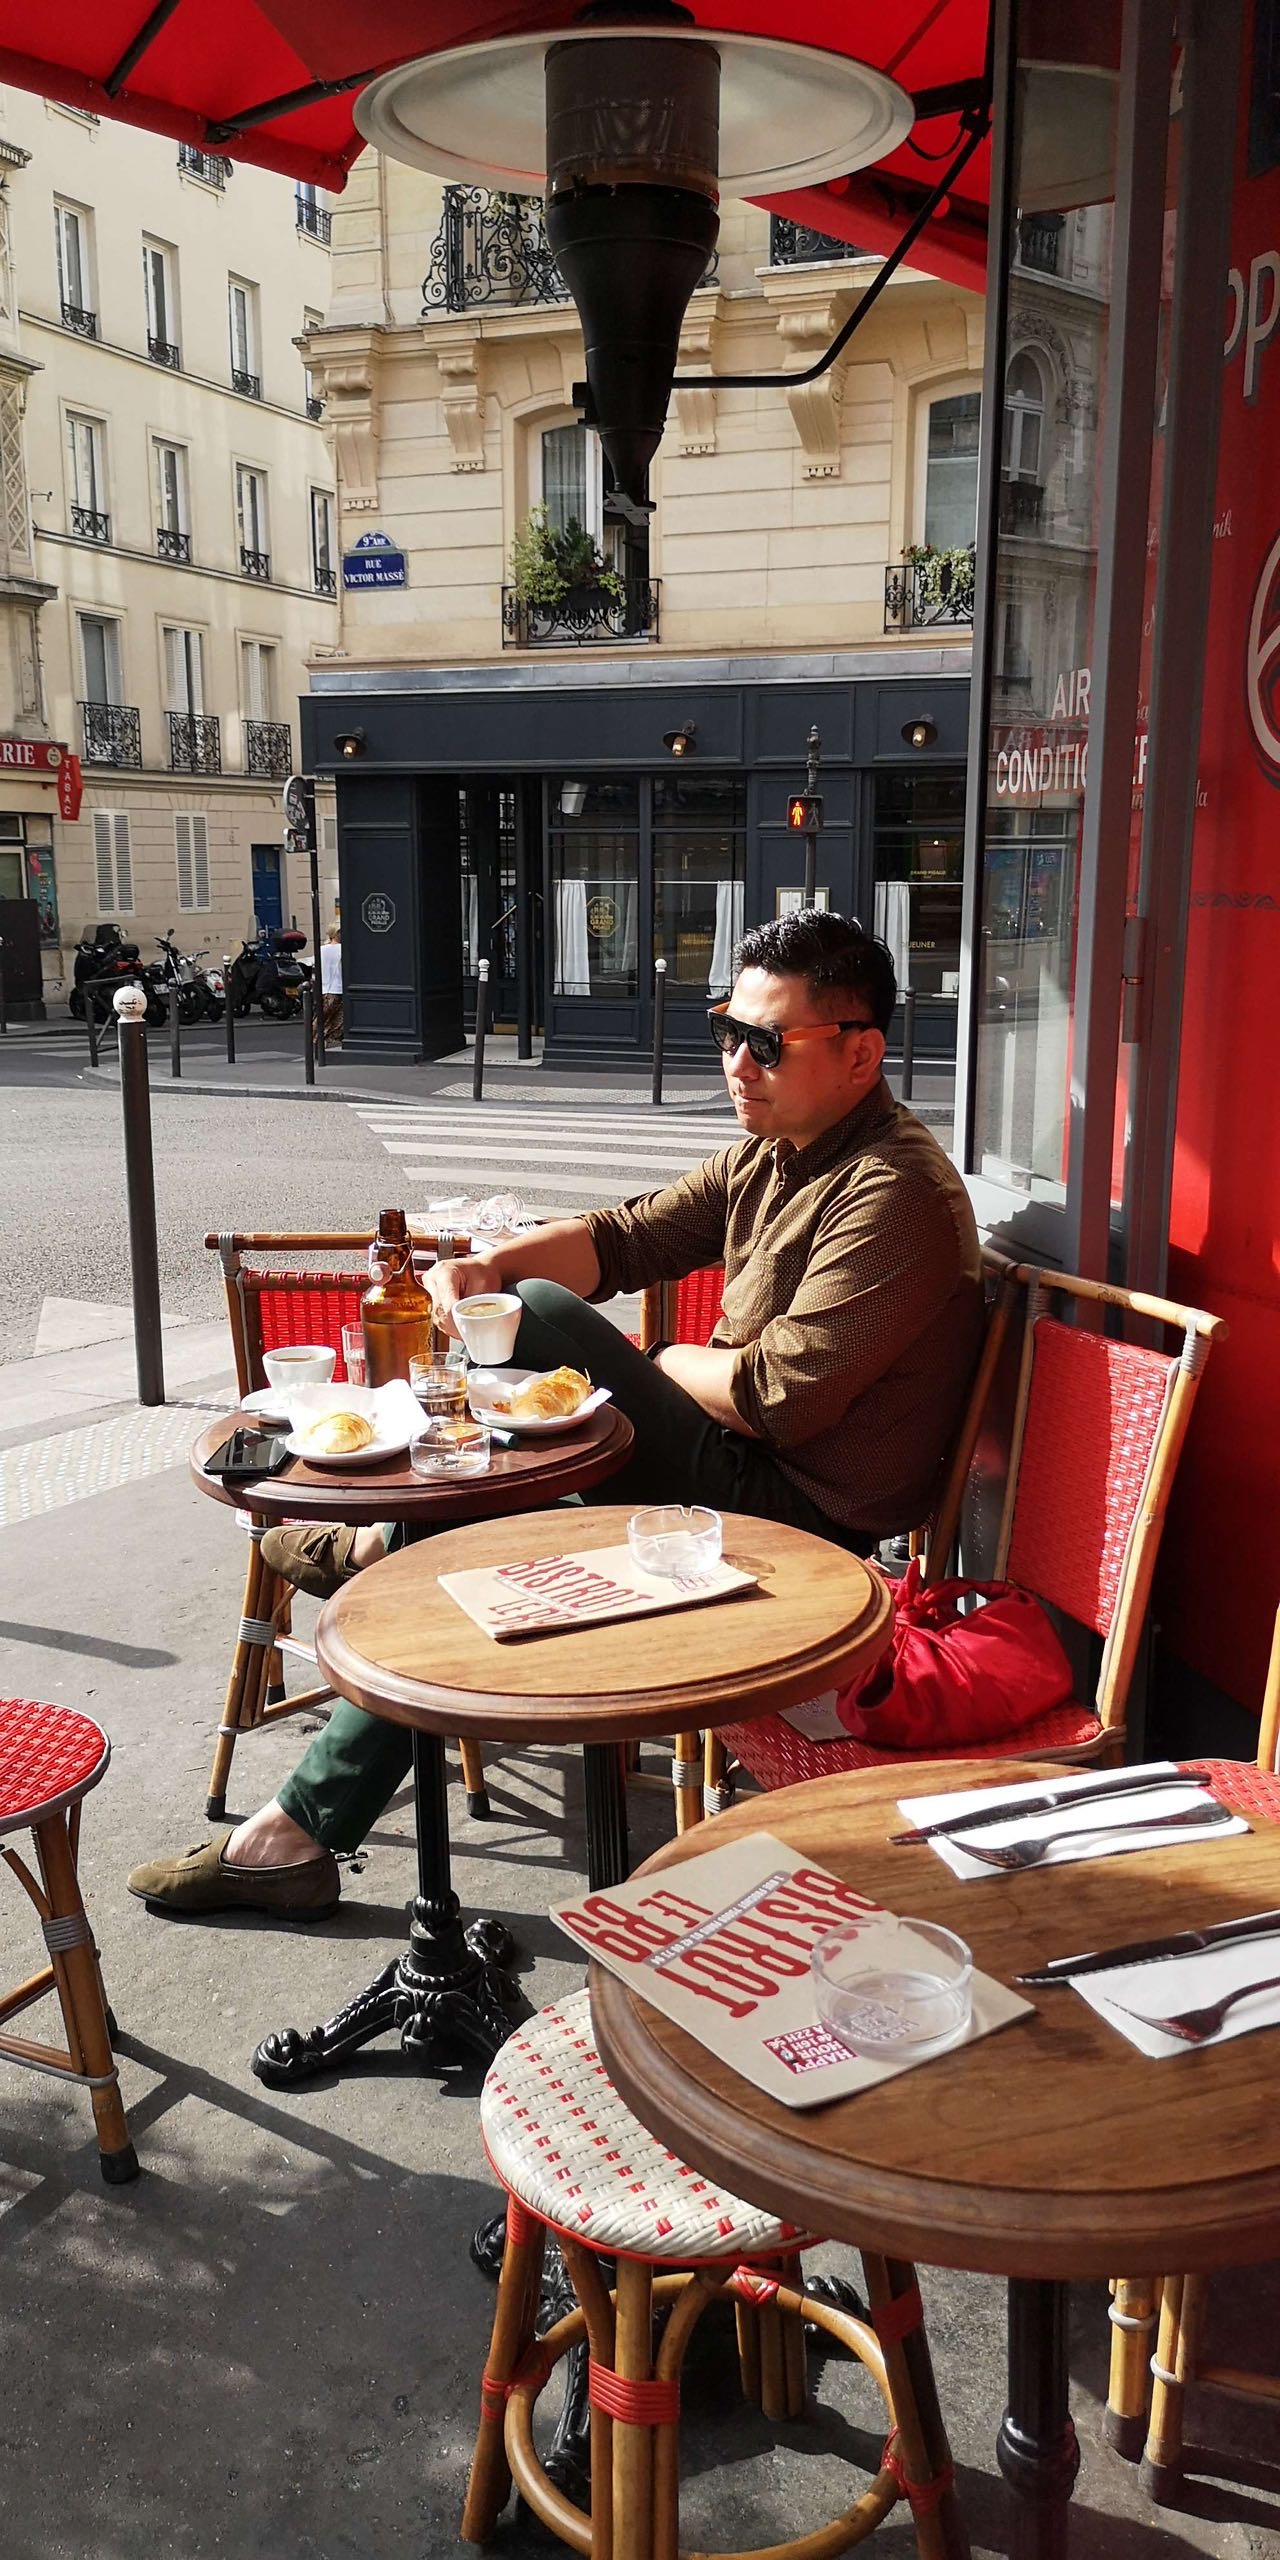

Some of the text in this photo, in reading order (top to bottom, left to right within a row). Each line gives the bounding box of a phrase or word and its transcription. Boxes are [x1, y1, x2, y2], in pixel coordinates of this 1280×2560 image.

[365, 559, 382, 569] RUE
[345, 569, 404, 583] VICTOR MASSÉ
[1052, 668, 1091, 720] AIR
[0, 742, 35, 765] RIE
[497, 1555, 655, 1616] BISTROT
[556, 1890, 714, 1963] LE B9
[654, 1868, 886, 2019] BISTROT
[784, 2028, 814, 2044] 22H
[790, 2033, 833, 2052] de 16H
[792, 2048, 853, 2073] HAPPY
[798, 2040, 843, 2060] HOUR
